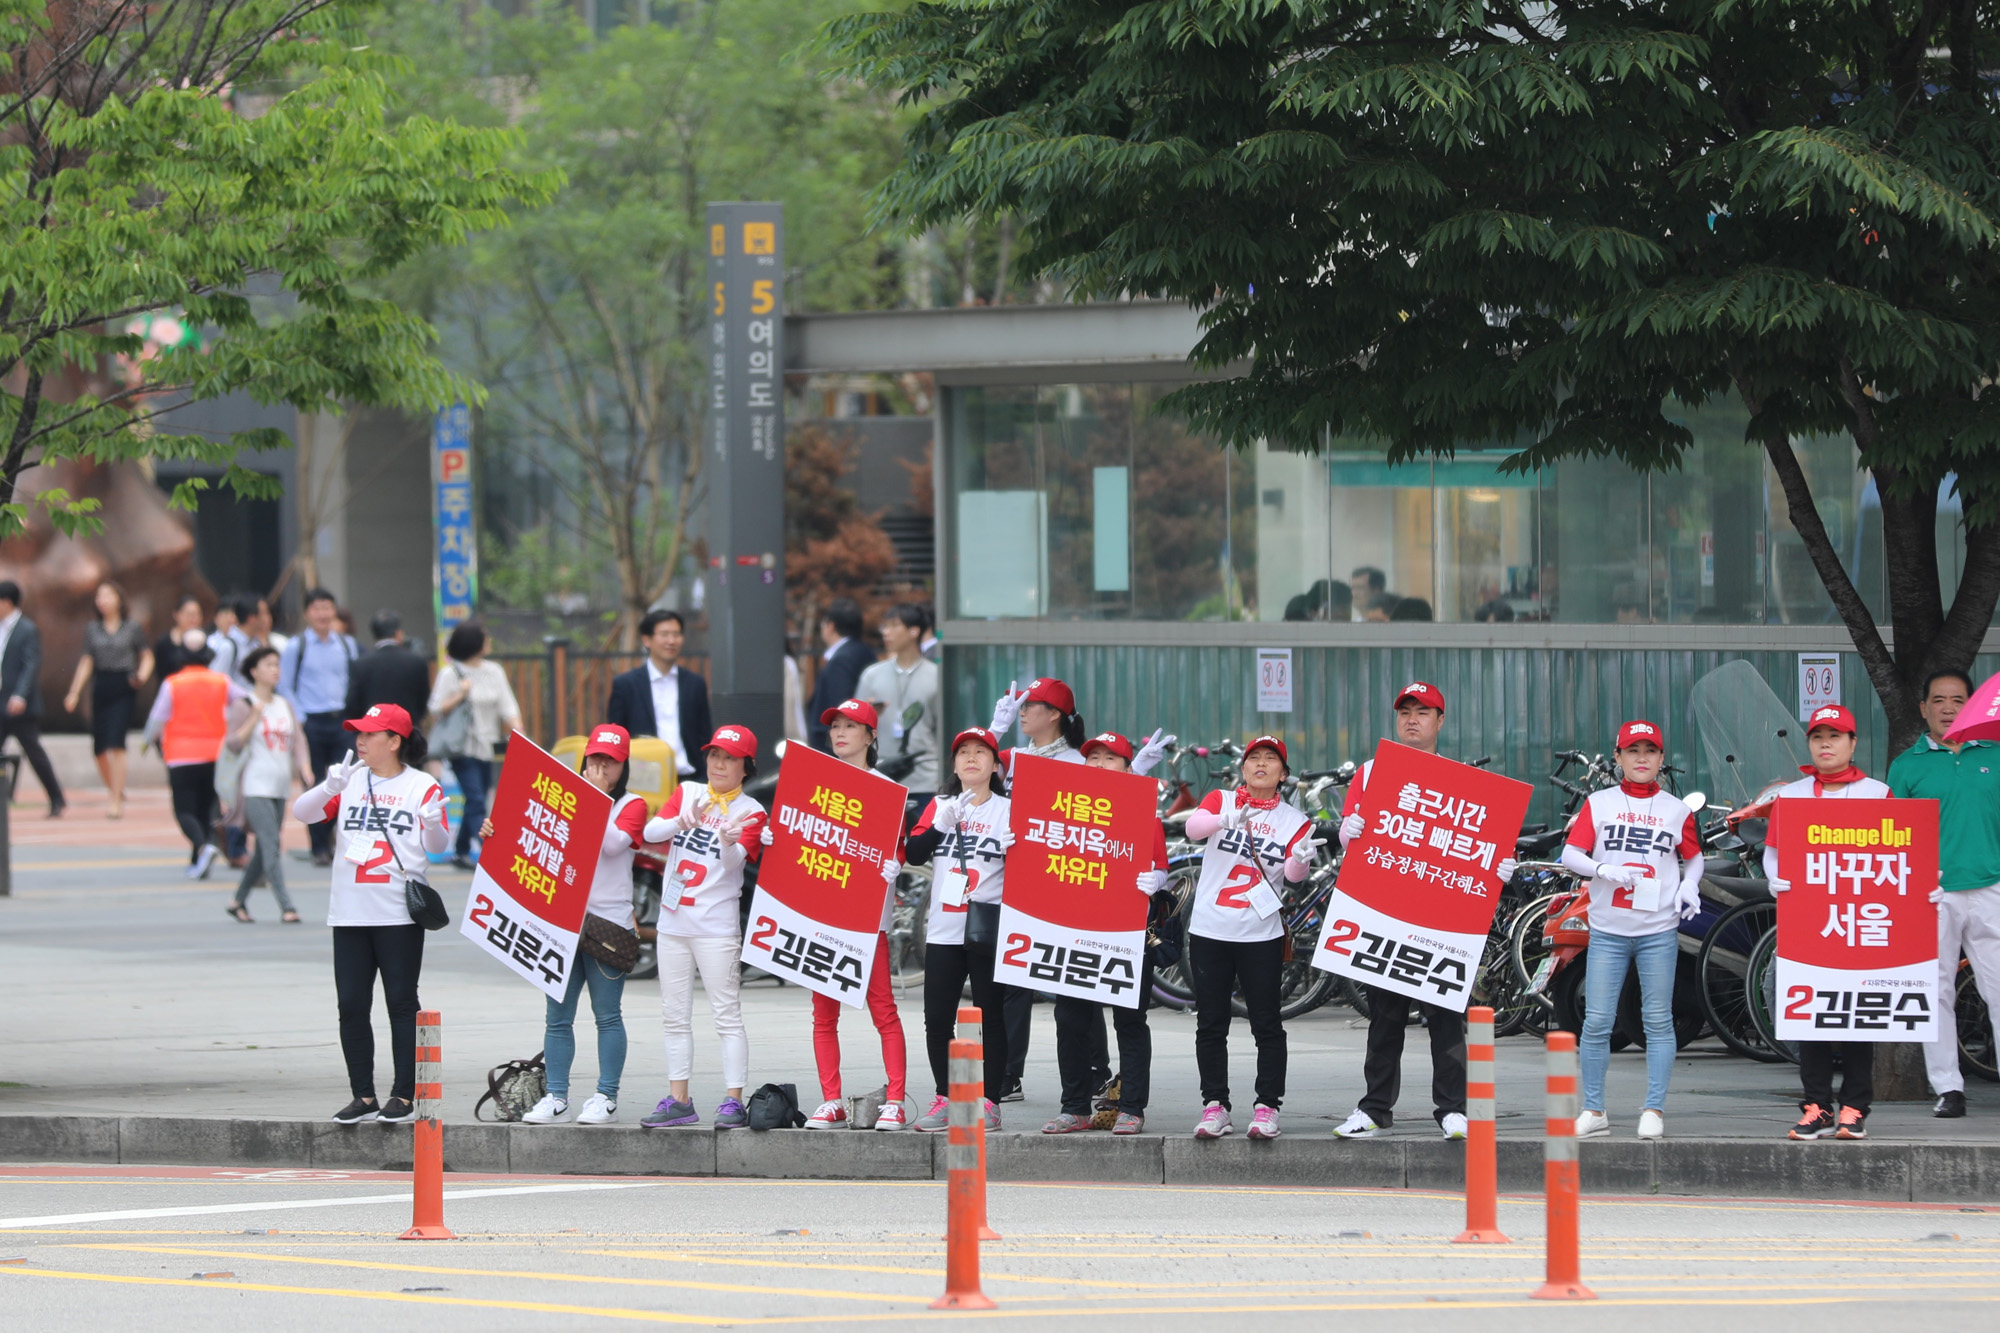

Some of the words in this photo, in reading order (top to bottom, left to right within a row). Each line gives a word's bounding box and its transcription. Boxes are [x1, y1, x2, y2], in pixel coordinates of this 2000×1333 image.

[751, 280, 775, 314] 5
[748, 319, 774, 406] 여의도
[441, 452, 464, 482] P
[441, 487, 472, 598] 주차장
[531, 772, 577, 820] 서울은
[809, 785, 863, 828] 서울은
[1051, 790, 1113, 826] 서울은
[1397, 781, 1487, 833] 출근시간
[343, 805, 414, 835] 김문수
[525, 798, 570, 848] 재건축
[779, 804, 883, 869] 미세먼지로부터
[1024, 817, 1134, 862] 교통지옥에서
[1373, 809, 1425, 848] 30분
[1428, 825, 1497, 871] 빠르게
[1604, 824, 1674, 857] 김문수
[1616, 812, 1657, 826] 서울시장
[1807, 824, 1880, 848] Change
[1881, 818, 1912, 848] Up!
[355, 840, 395, 884] 2
[517, 827, 564, 877] 재개발
[797, 845, 852, 889] 자유다
[1217, 828, 1285, 867] 김문수
[510, 854, 557, 905] 자유다
[1046, 854, 1108, 890] 자유다
[1215, 864, 1262, 909] 2
[1363, 845, 1488, 898] 상습정체구간해소
[1805, 851, 1912, 896] 바꾸자
[469, 893, 494, 930] 2
[487, 909, 564, 984] 김문수
[1820, 902, 1893, 947] 서울
[750, 915, 778, 952] 2
[771, 928, 862, 993] 김문수
[1002, 932, 1031, 968] 2
[1029, 941, 1135, 995] 김문수
[1324, 919, 1360, 957] 2
[1350, 931, 1467, 996] 김문수
[1784, 985, 1814, 1020] 2
[1814, 991, 1931, 1031] 김문수
